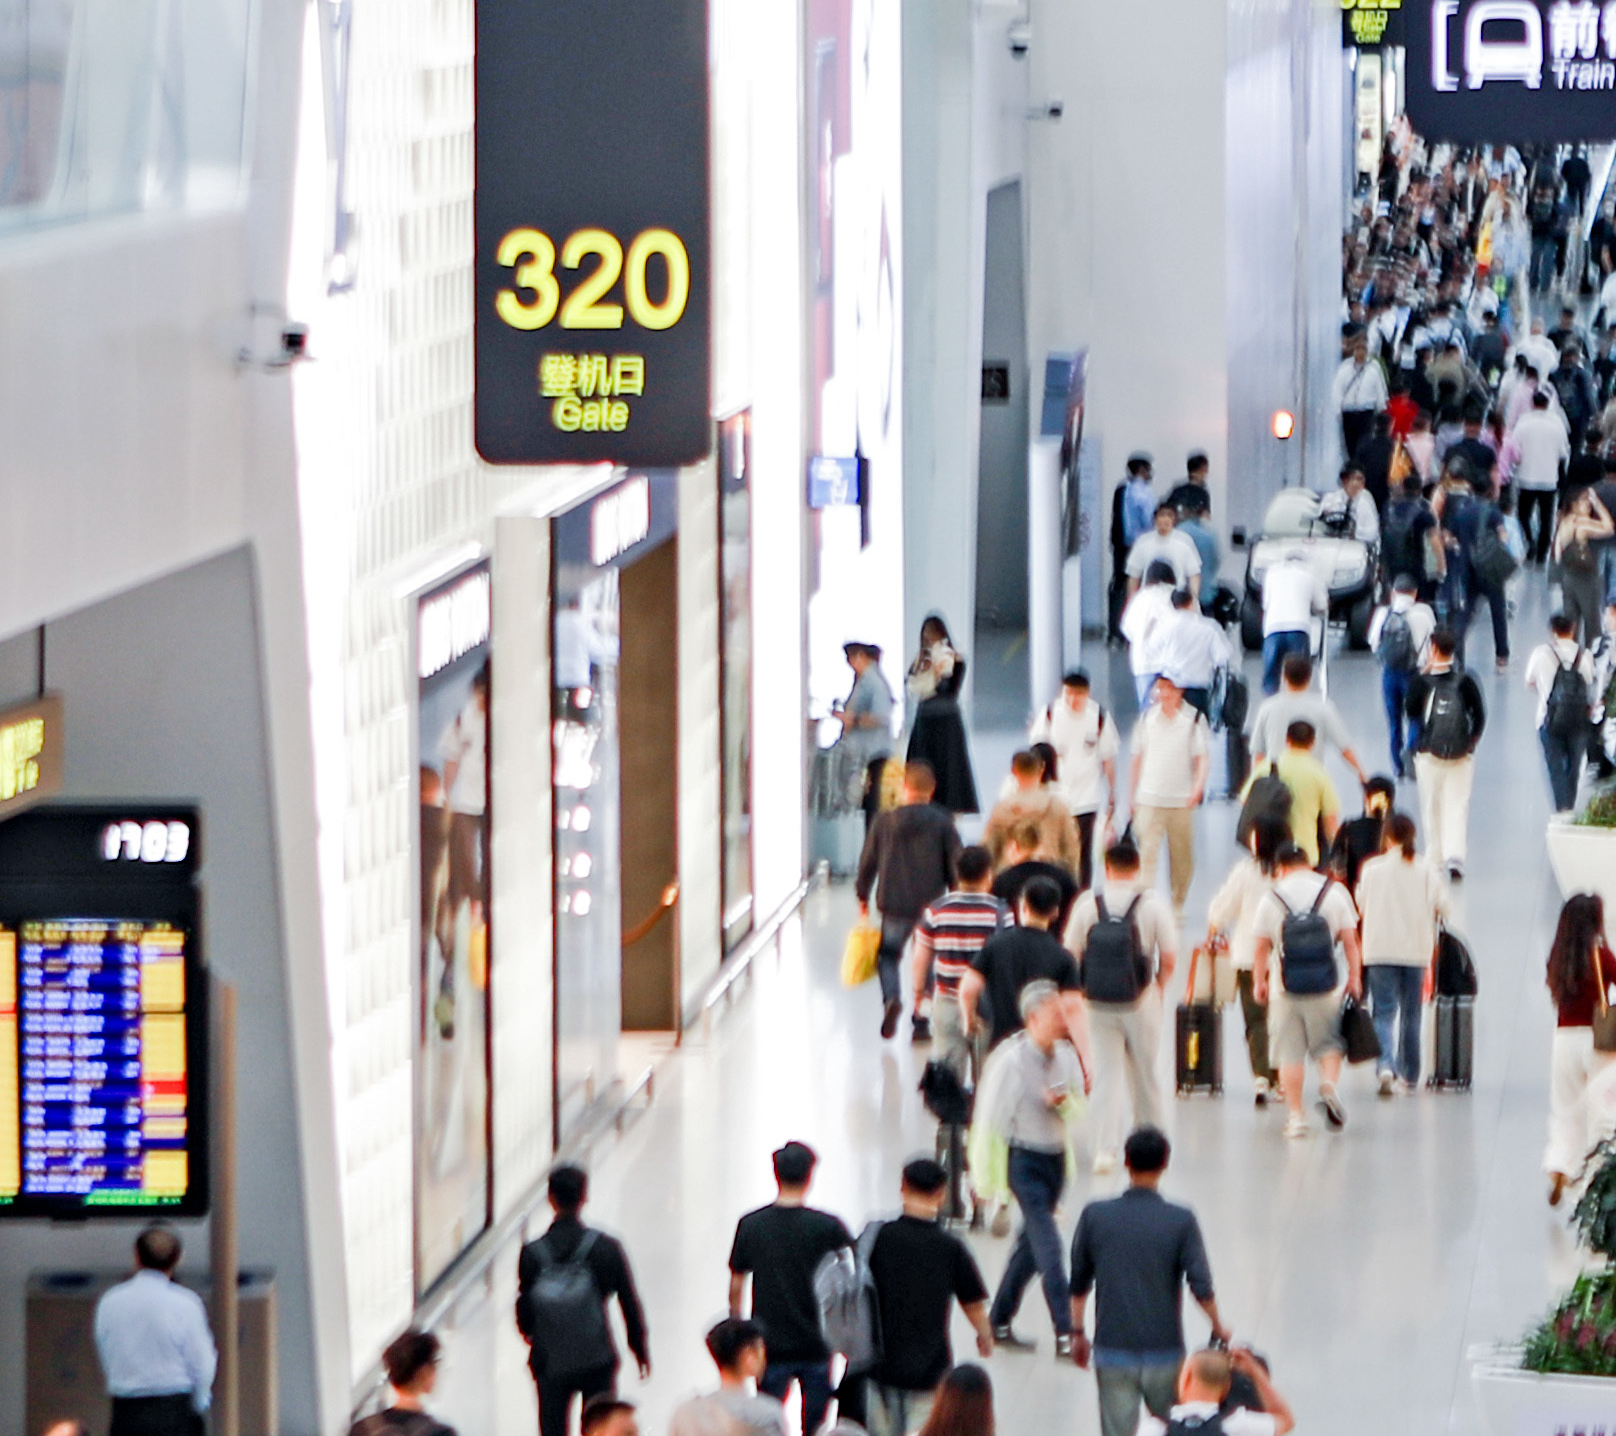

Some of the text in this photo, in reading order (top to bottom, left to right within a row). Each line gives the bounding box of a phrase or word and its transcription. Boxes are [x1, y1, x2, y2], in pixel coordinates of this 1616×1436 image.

[495, 228, 691, 331] 320
[540, 355, 646, 398] 登机口
[551, 397, 630, 433] Gate
